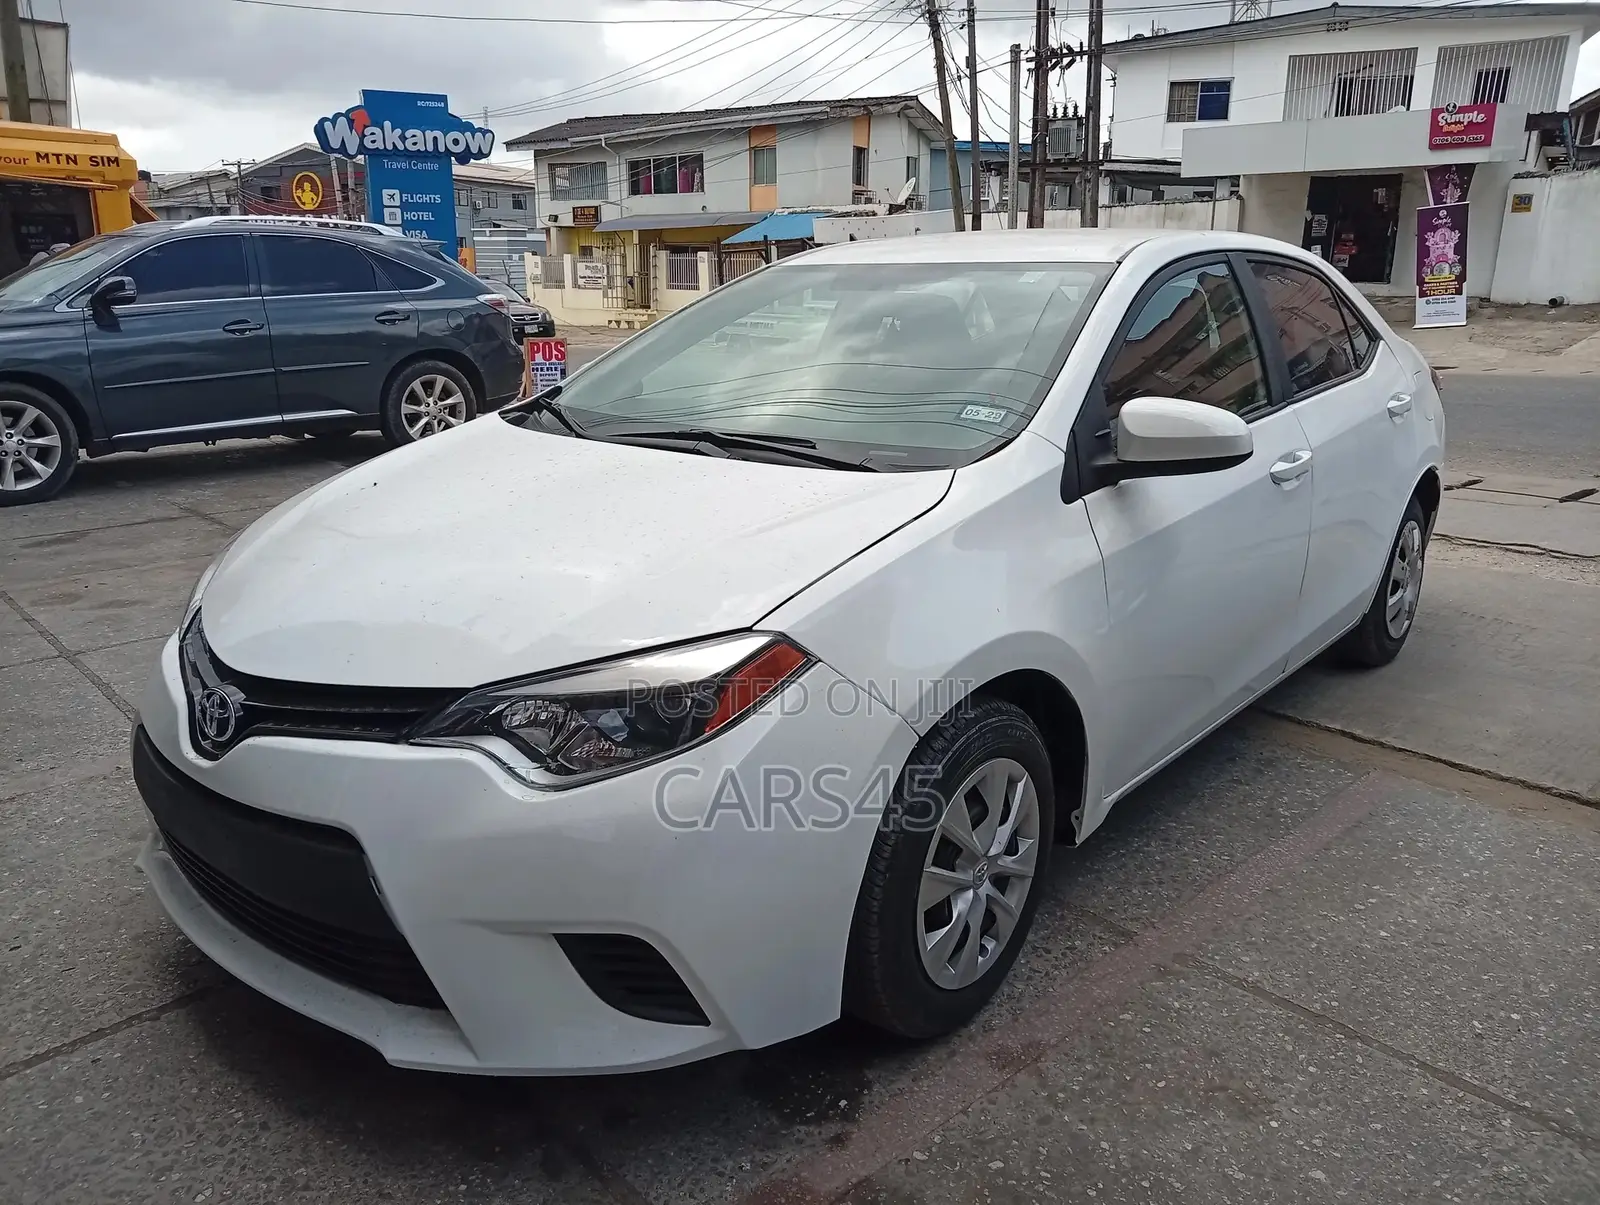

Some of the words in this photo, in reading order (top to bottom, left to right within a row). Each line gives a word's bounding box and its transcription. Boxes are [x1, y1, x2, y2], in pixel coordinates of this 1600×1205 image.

[1437, 111, 1487, 126] Simple
[323, 109, 493, 155] Wakanow
[0, 155, 30, 165] our
[35, 151, 79, 166] MTN
[88, 155, 121, 168] SIM
[383, 159, 409, 170] Travel
[411, 160, 439, 171] Centre
[402, 193, 441, 204] FLIGHTS
[403, 211, 435, 221] HOTEL
[405, 230, 429, 239] VISA
[529, 341, 566, 362] POS
